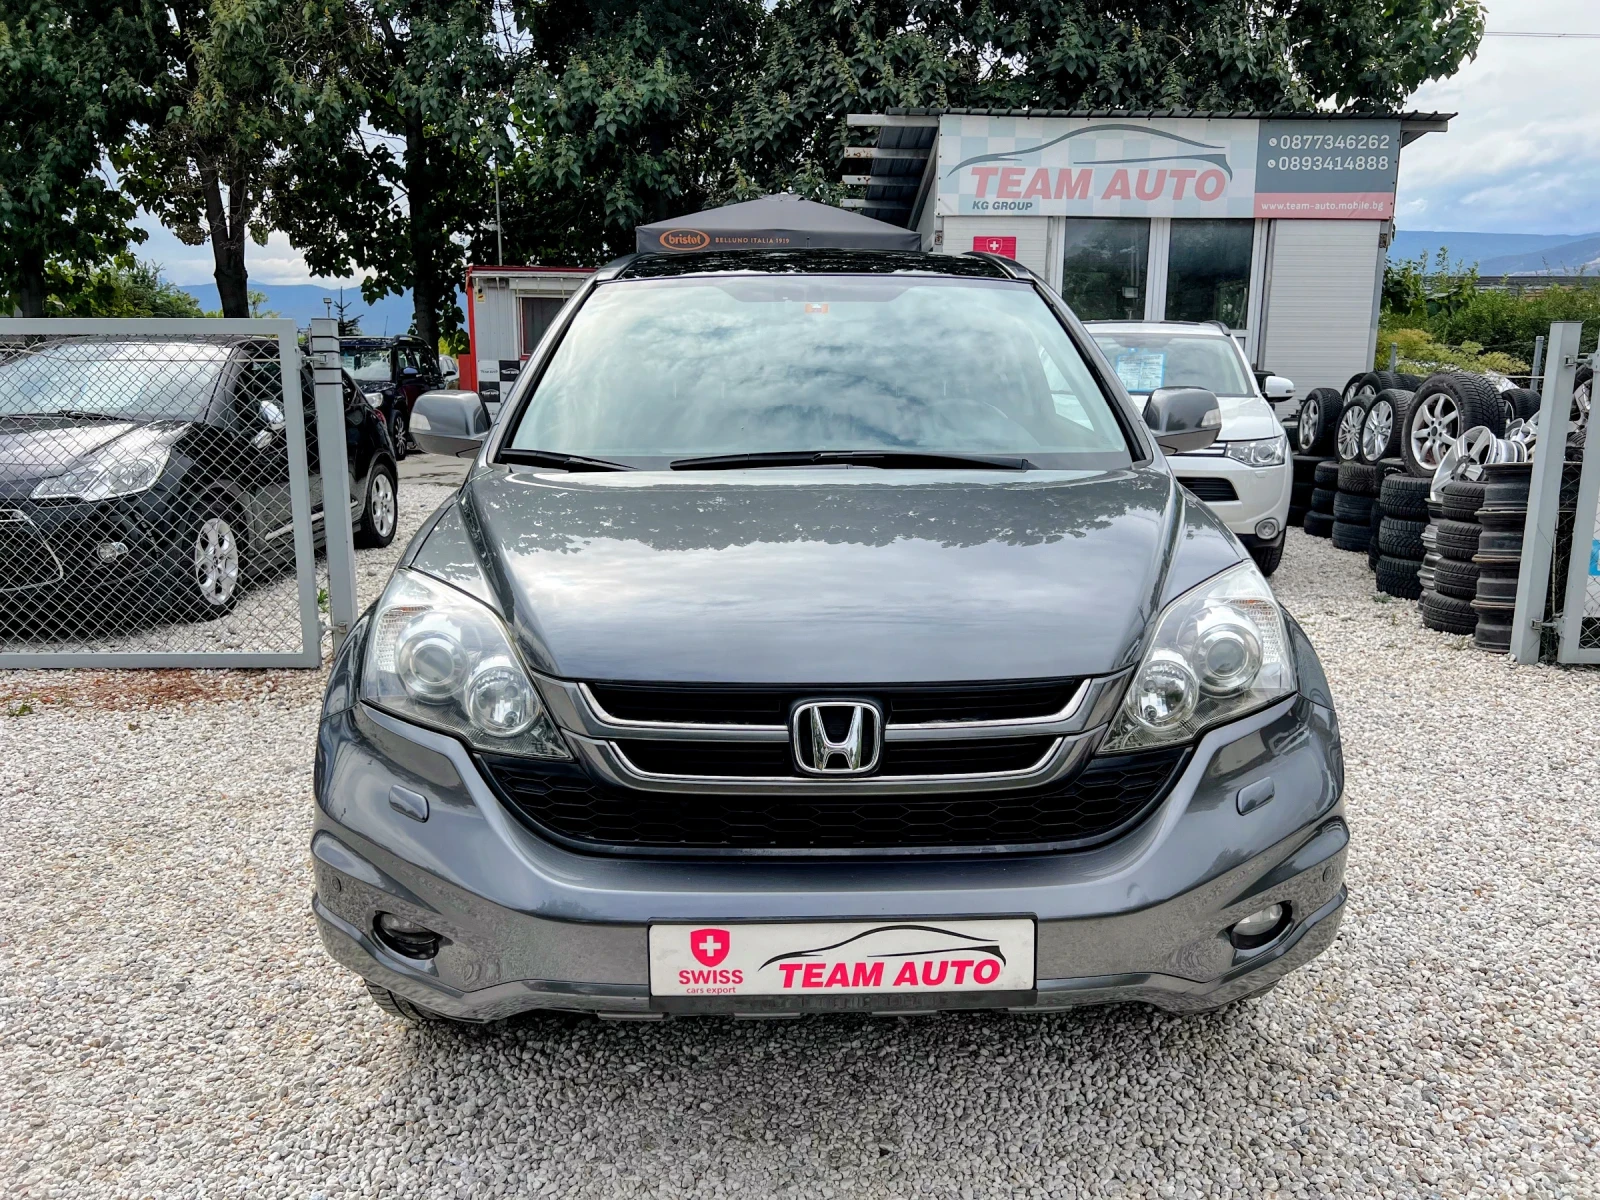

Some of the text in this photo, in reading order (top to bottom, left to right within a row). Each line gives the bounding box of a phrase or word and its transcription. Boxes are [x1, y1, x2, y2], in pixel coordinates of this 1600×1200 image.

[1280, 134, 1390, 150] 0877346262
[1278, 156, 1389, 171] 0893414888
[971, 167, 1226, 201] TEAM AUTO
[972, 201, 1033, 212] KG GROUP
[1261, 201, 1384, 212] www.team-auto.mobile.bg
[668, 234, 701, 245] bristot
[678, 969, 744, 985] SWISS
[779, 959, 1001, 989] TEAM AUTO
[706, 986, 736, 995] export
